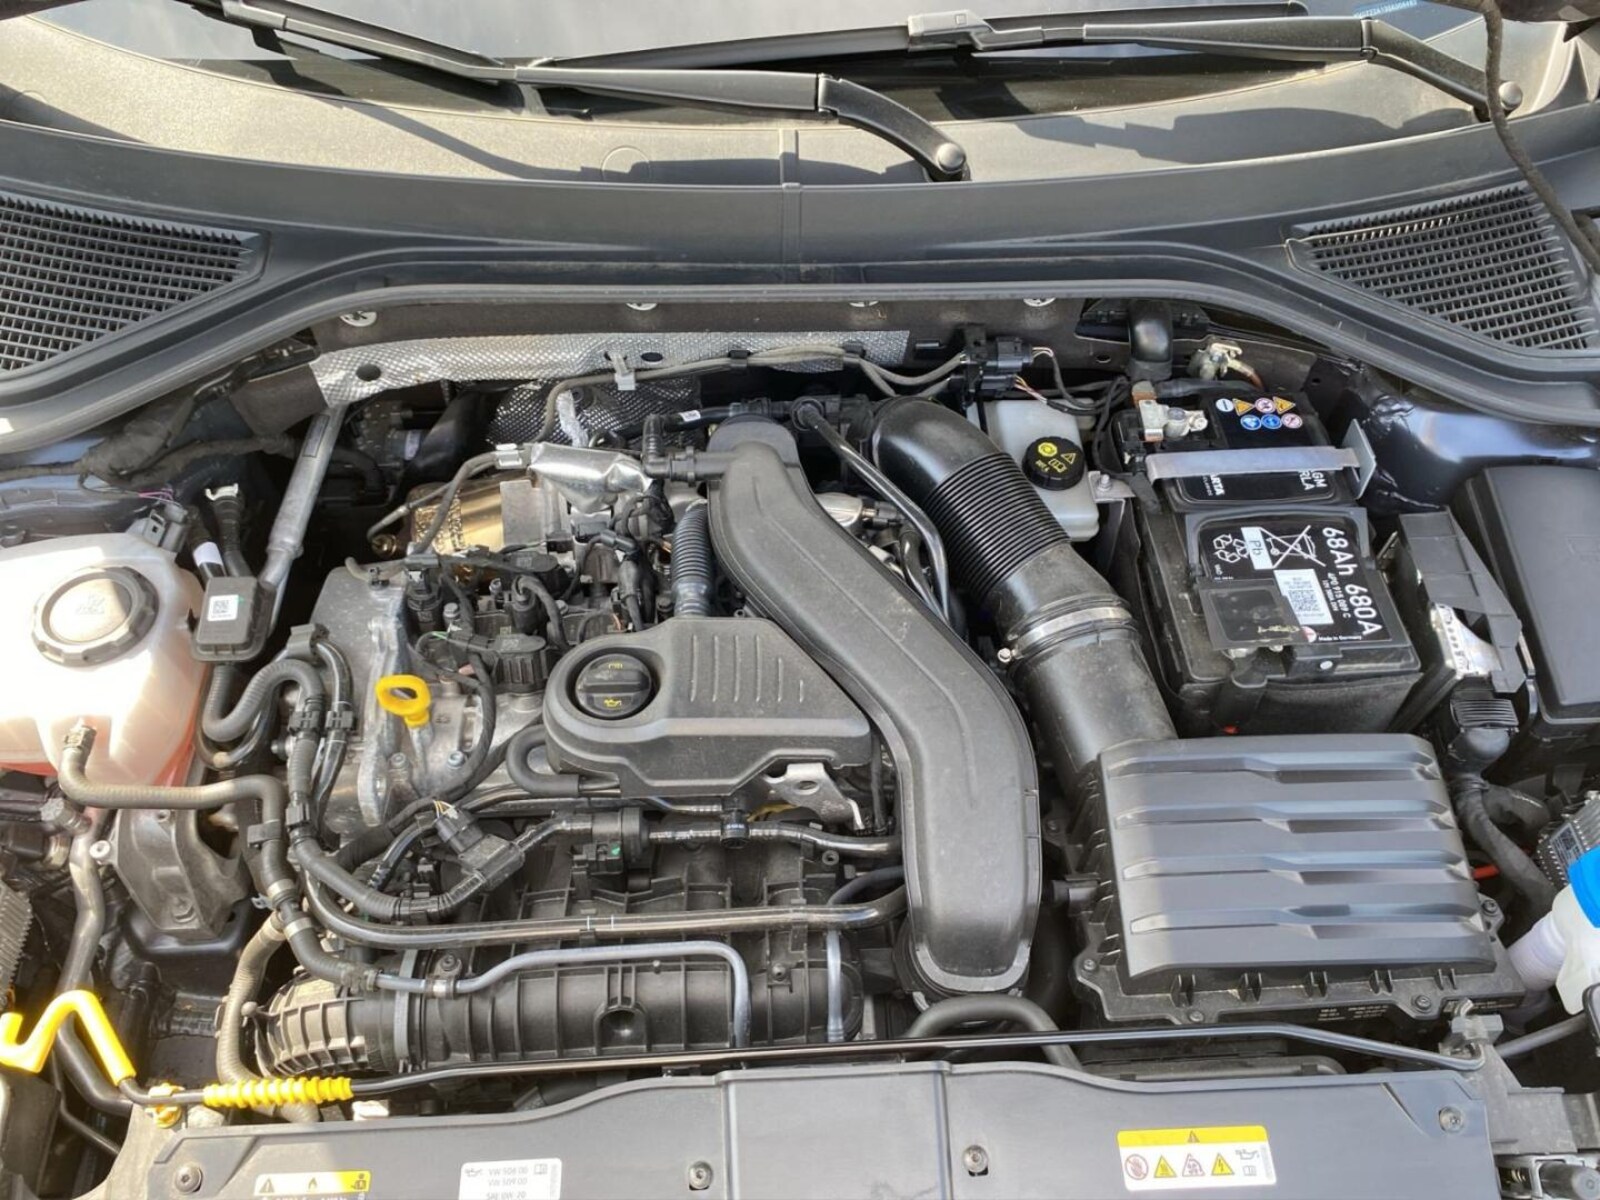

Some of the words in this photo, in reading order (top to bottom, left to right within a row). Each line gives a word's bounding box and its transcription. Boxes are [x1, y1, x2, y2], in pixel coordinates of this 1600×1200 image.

[1210, 474, 1226, 496] RTA
[1300, 470, 1315, 491] RLA
[1311, 471, 1328, 488] GM
[1248, 540, 1264, 556] Pb
[1322, 527, 1359, 576] 68Ah
[1345, 584, 1383, 636] 680A
[1332, 585, 1345, 599] 915
[1342, 611, 1352, 619] C
